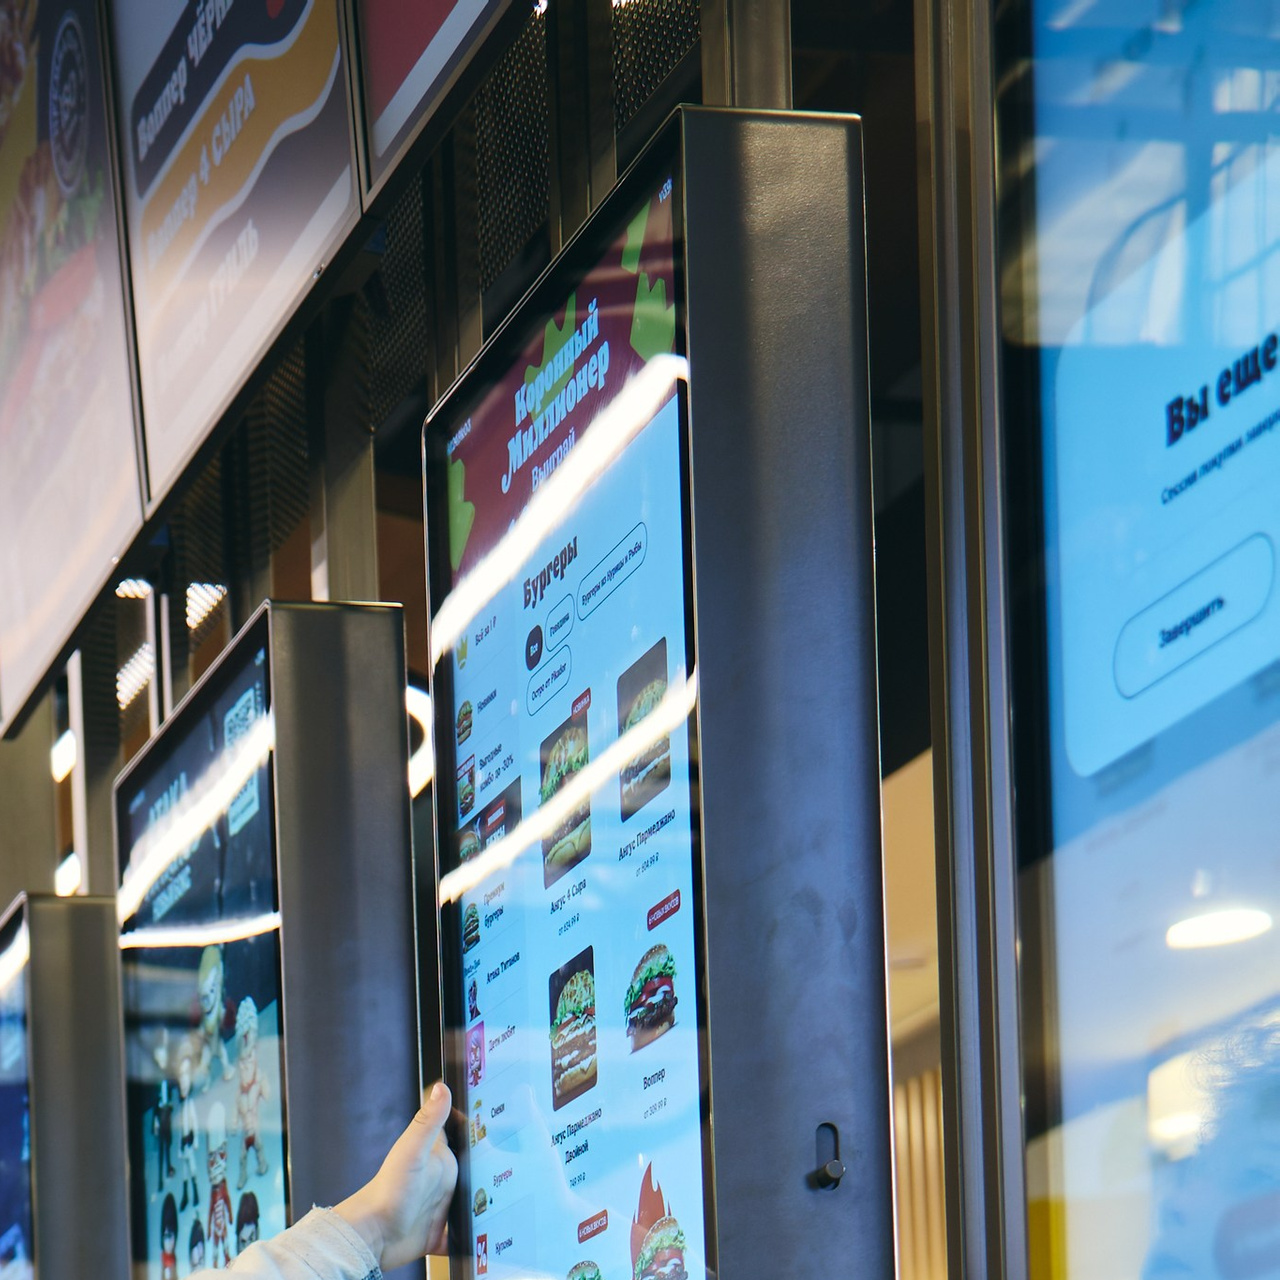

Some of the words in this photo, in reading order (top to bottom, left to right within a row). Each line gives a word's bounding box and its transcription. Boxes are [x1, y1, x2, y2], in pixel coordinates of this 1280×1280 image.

[137, 56, 187, 162] Воппер
[200, 144, 210, 186] 4
[212, 73, 256, 166] СЫРА
[515, 298, 599, 427] Коронный
[1166, 384, 1209, 448] Вы
[1216, 333, 1279, 407] еще
[502, 341, 609, 494] Миллионер
[532, 427, 576, 492] Выиграй
[523, 535, 578, 610] Бургеры
[1158, 596, 1225, 648] Завершить
[618, 840, 636, 862] Ангус
[636, 809, 676, 847] Пармеджано
[550, 895, 566, 915] Ангус
[571, 878, 587, 897] Сыра
[486, 967, 500, 985] Атака
[500, 951, 520, 973] Титанов
[643, 1068, 666, 1090] Воппер
[550, 1129, 566, 1147] Ангус
[565, 1139, 589, 1165] Двойной
